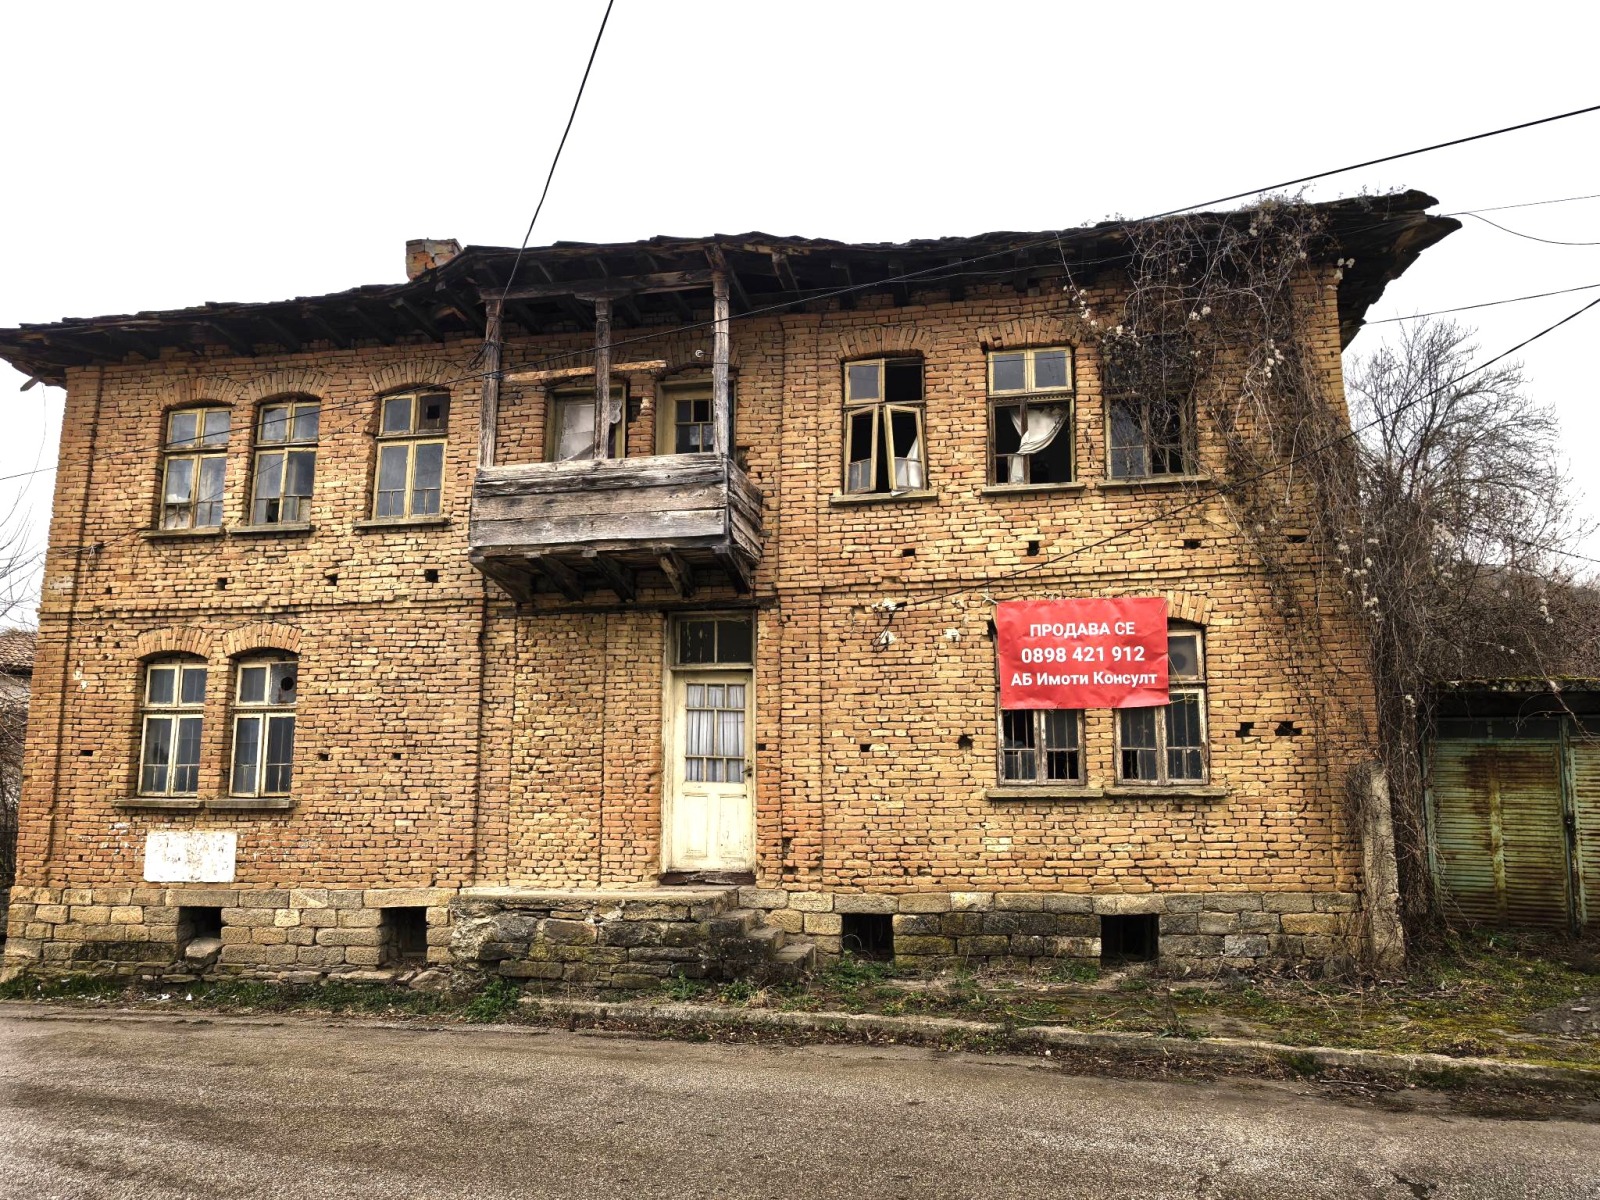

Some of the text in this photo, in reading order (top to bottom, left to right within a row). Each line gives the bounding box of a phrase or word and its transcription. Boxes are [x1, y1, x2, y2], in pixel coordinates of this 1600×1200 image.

[1029, 621, 1136, 639] ПРОДАВА СЕ
[1021, 645, 1145, 664] 0898 421 912
[1011, 671, 1158, 688] АБ Имоти Консулт
